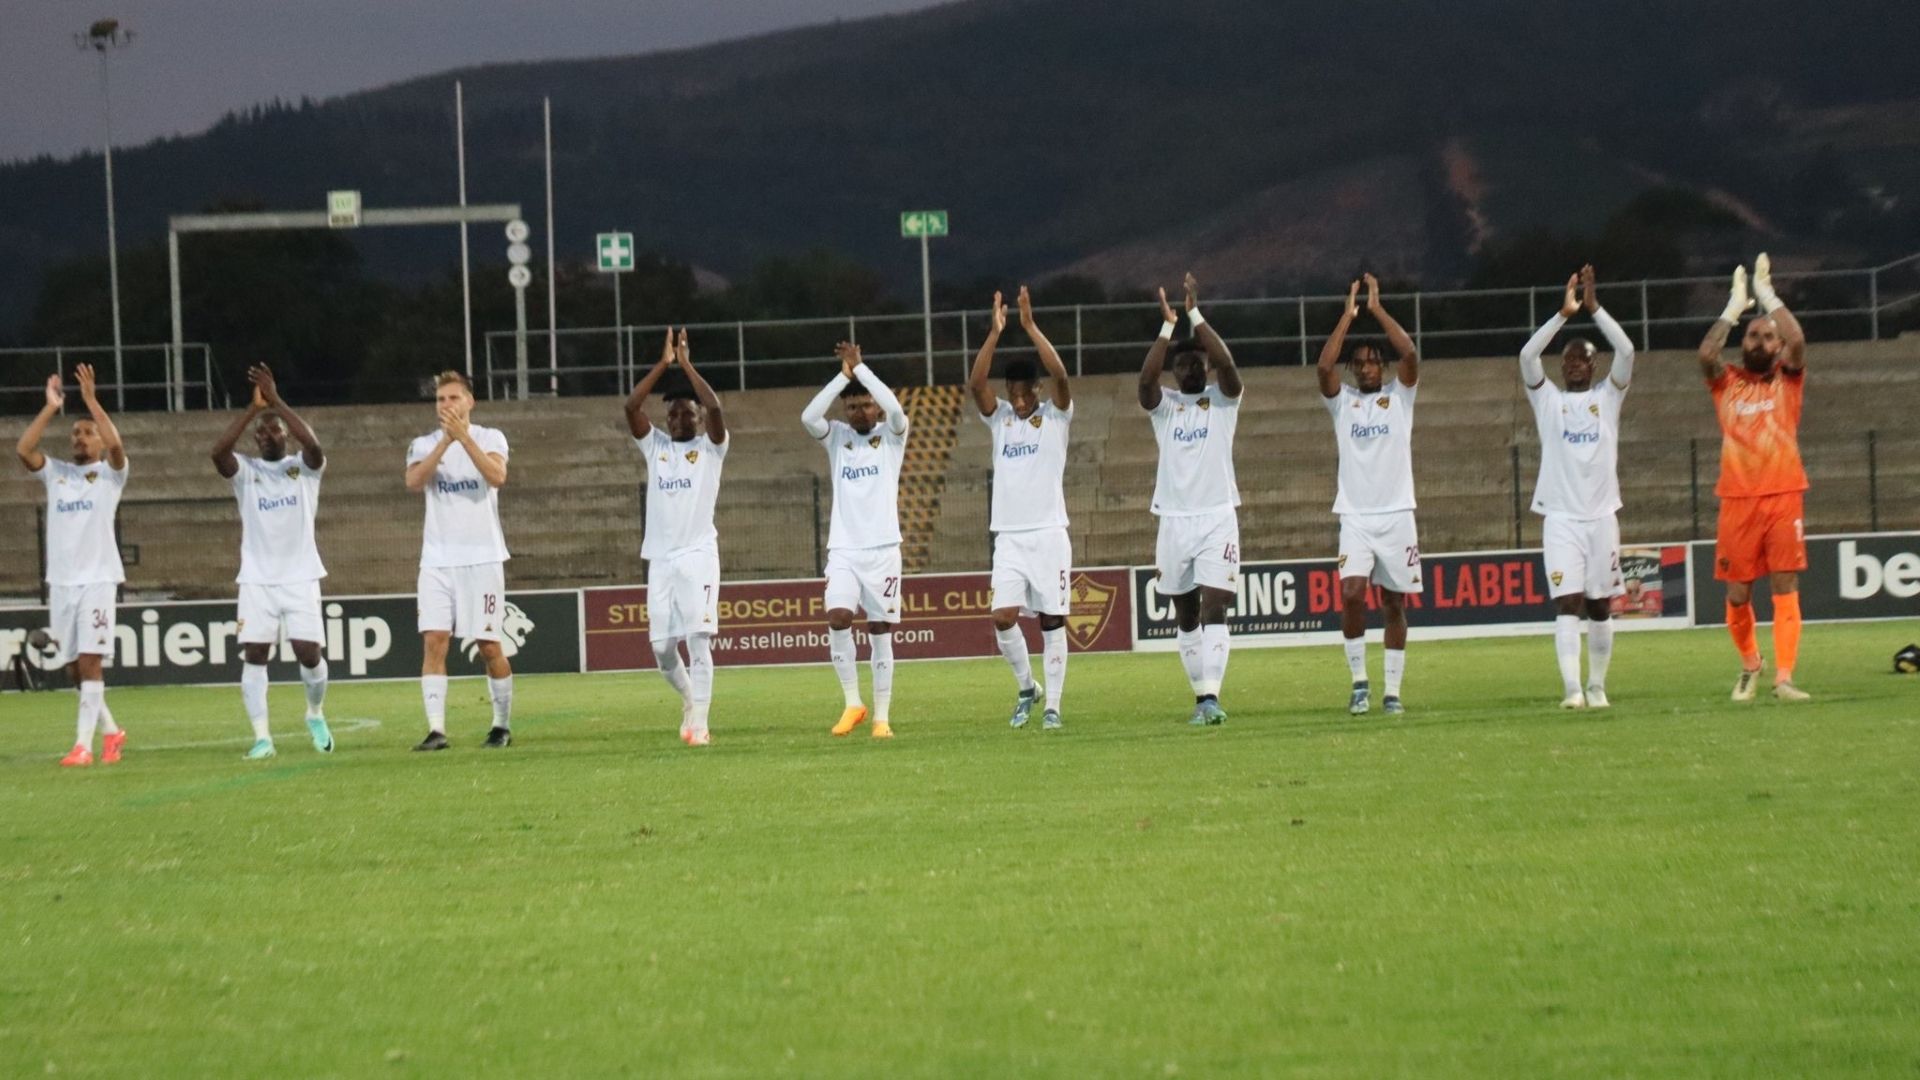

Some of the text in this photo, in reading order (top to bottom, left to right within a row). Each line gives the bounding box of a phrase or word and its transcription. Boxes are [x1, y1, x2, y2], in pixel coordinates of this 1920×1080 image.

[1174, 427, 1208, 441] Rama
[1351, 424, 1389, 437] Rama
[842, 465, 878, 479] Rama
[438, 479, 479, 494] Rama
[258, 496, 297, 511] Rama
[1794, 519, 1804, 541] 1
[883, 577, 898, 598] 27
[1060, 570, 1066, 590] 5
[1433, 561, 1544, 608] LABEL
[484, 594, 496, 615] 18
[704, 585, 711, 605] 7
[92, 609, 109, 630] 34
